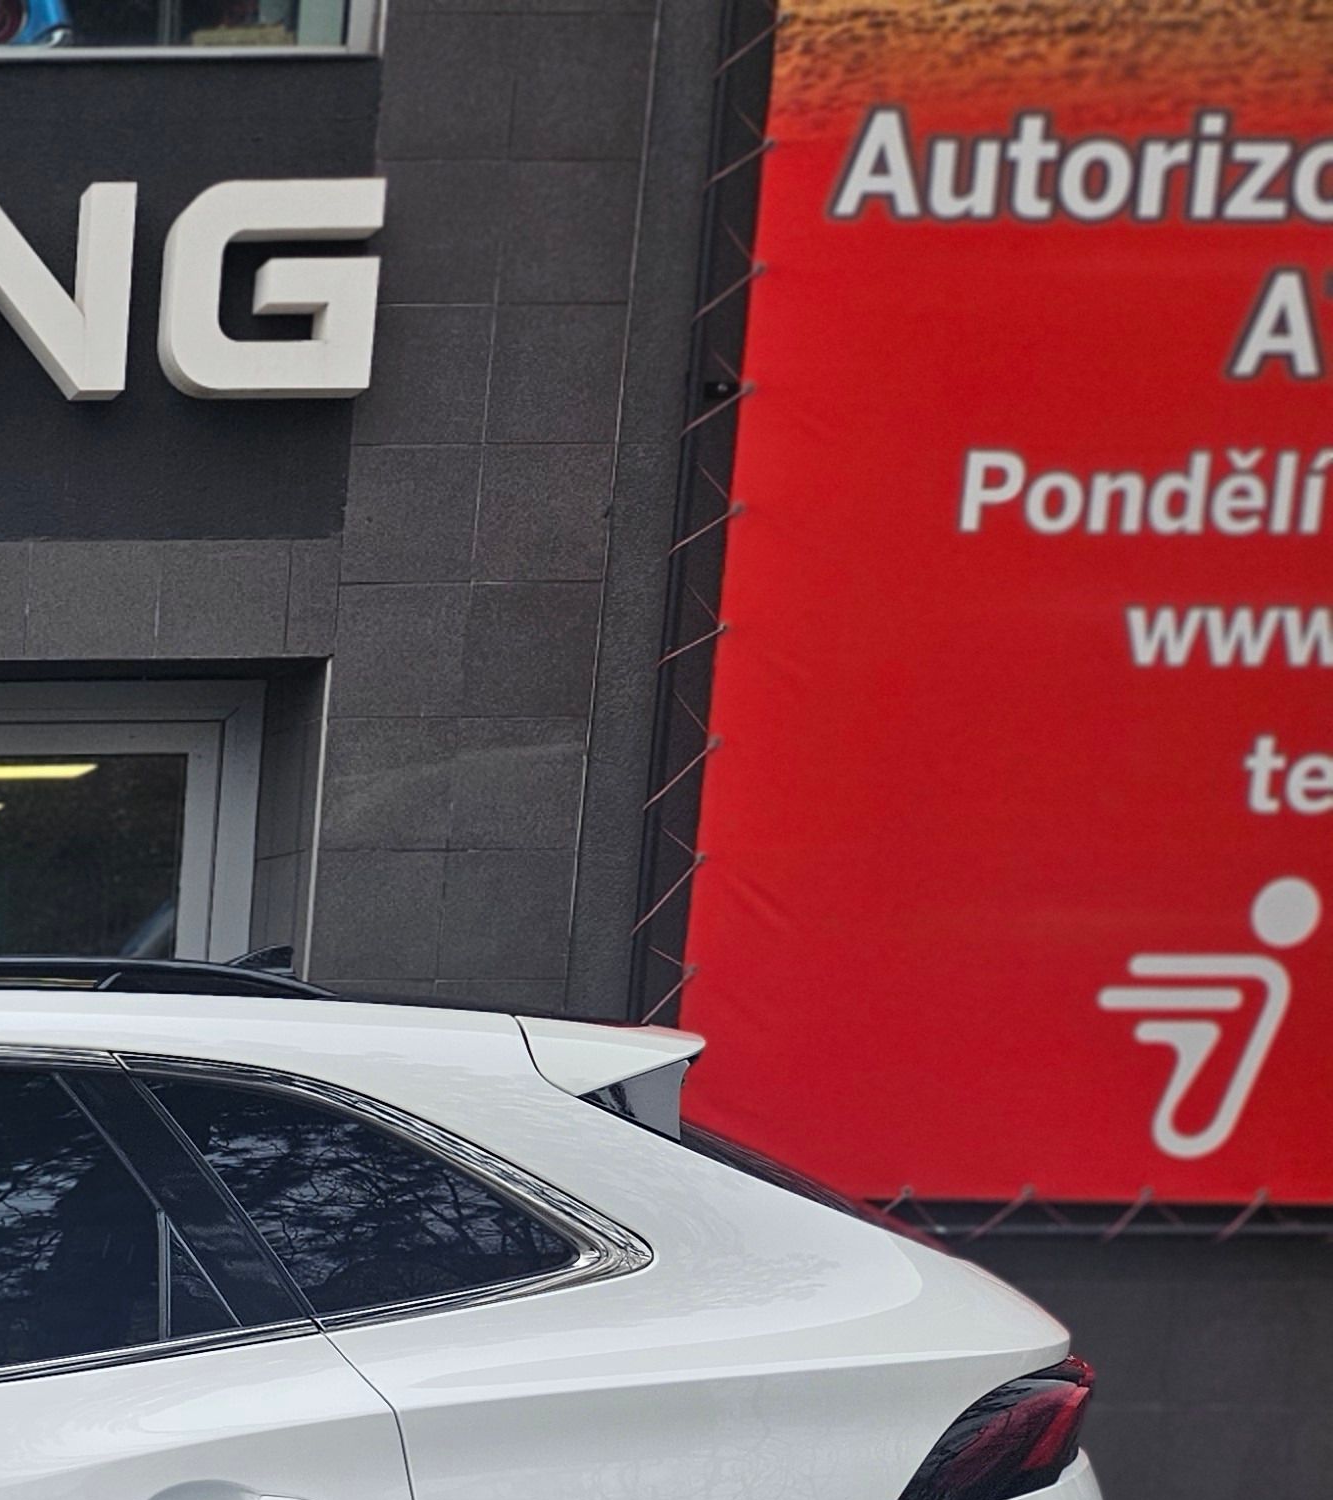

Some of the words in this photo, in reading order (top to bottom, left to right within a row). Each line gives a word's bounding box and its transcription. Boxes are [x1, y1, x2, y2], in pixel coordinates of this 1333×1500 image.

[1230, 269, 1333, 378] A
[957, 446, 1333, 536] Pondělí
[1126, 605, 1333, 668] www
[1243, 733, 1333, 814] te
